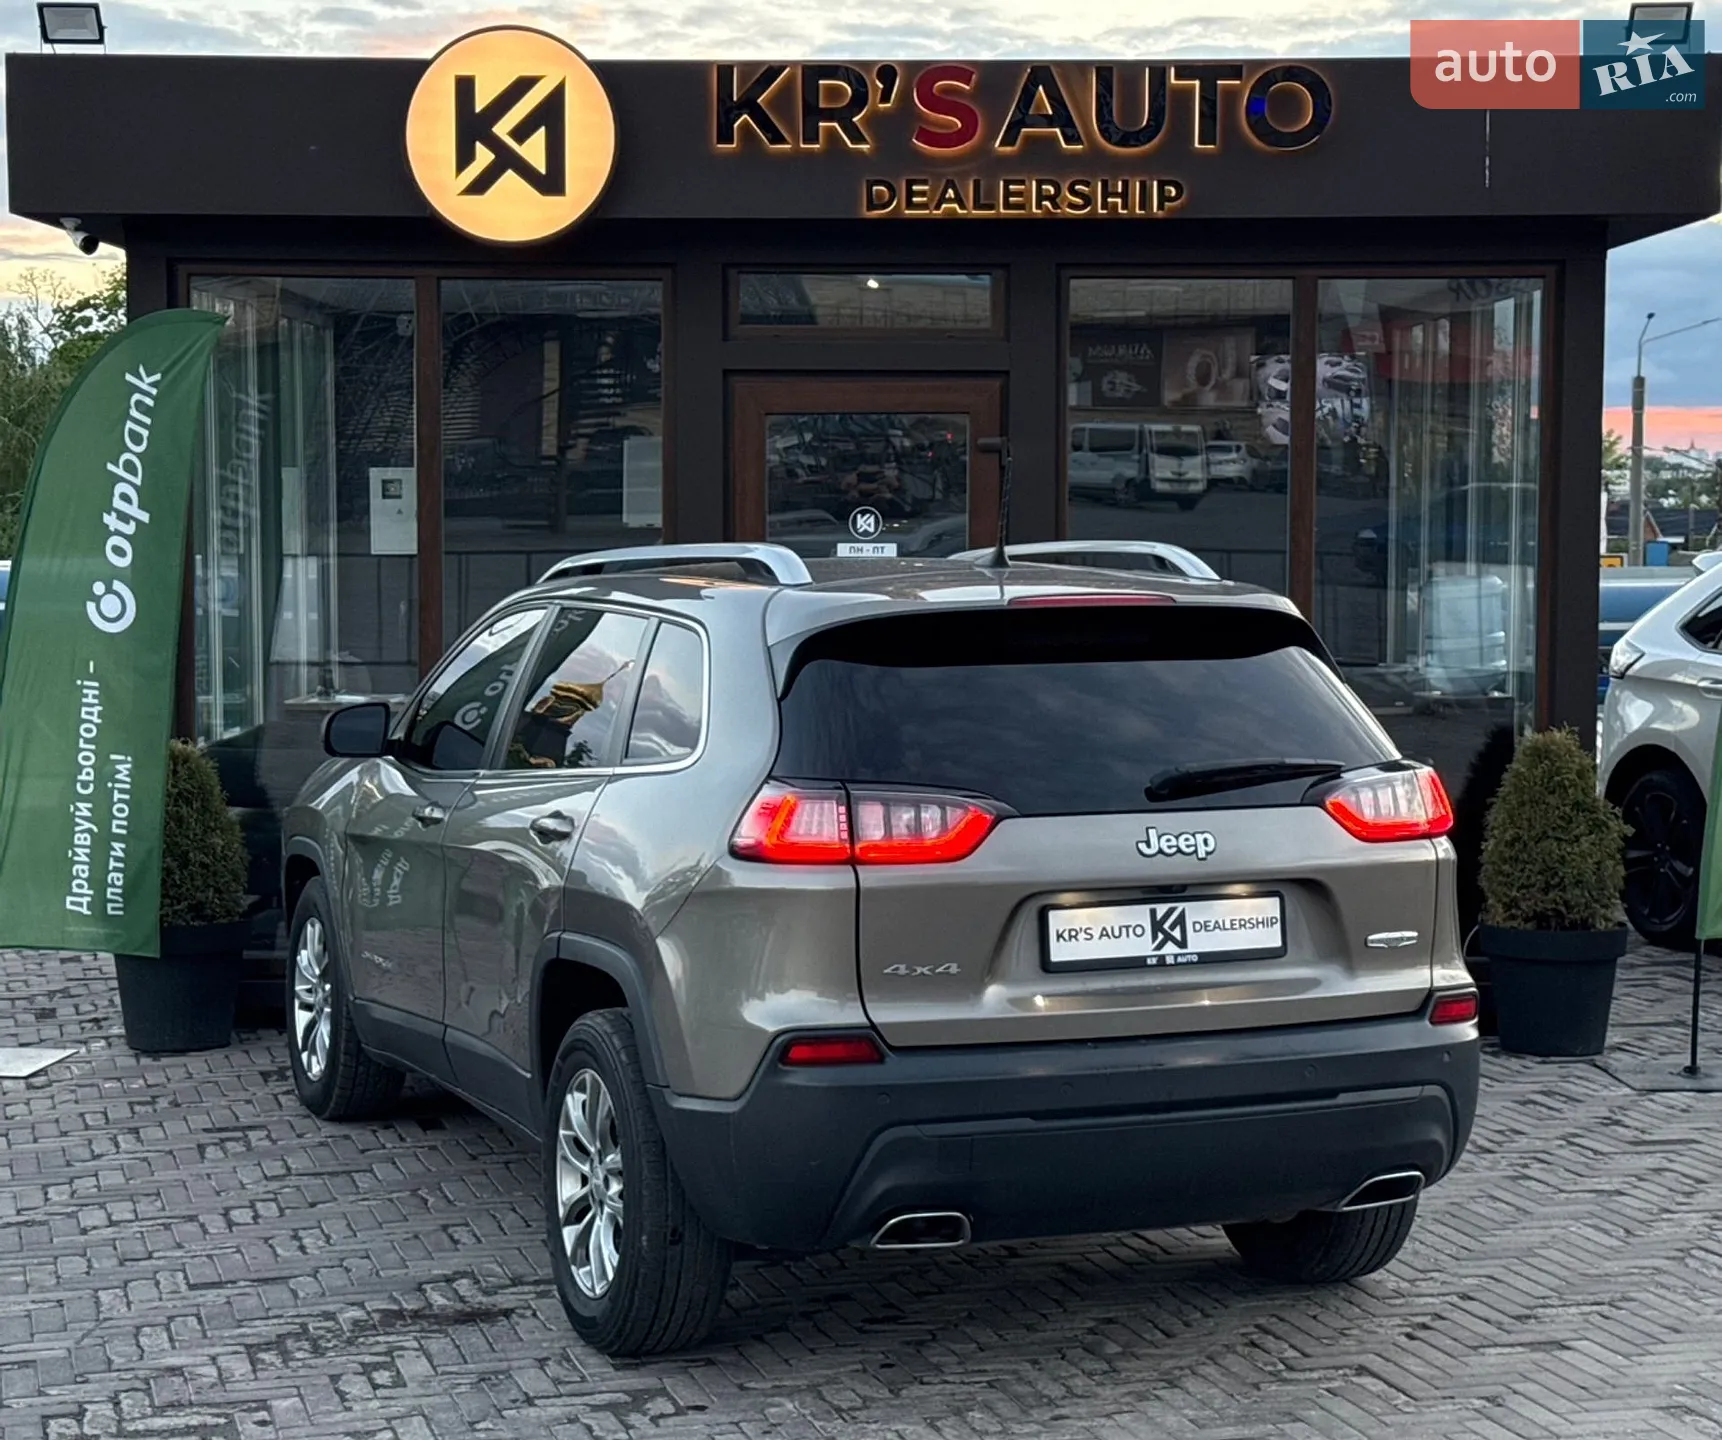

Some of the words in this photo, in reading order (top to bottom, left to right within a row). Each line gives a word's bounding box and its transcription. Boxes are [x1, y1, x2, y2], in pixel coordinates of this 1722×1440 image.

[995, 63, 1333, 150] AUTO
[865, 178, 1185, 213] DEALERSHIP
[101, 363, 162, 569] otpbank
[76, 679, 104, 795] сьогодні
[107, 753, 133, 835] потім!
[66, 804, 99, 916] Драйвуй
[106, 841, 127, 916] плати
[1136, 827, 1217, 860] Jeep
[1055, 925, 1095, 944] KR'S
[1098, 923, 1146, 941] AUTO
[1192, 915, 1279, 934] DEALERSHIP
[1176, 954, 1199, 964] AUTO
[883, 962, 962, 976] 4x4
